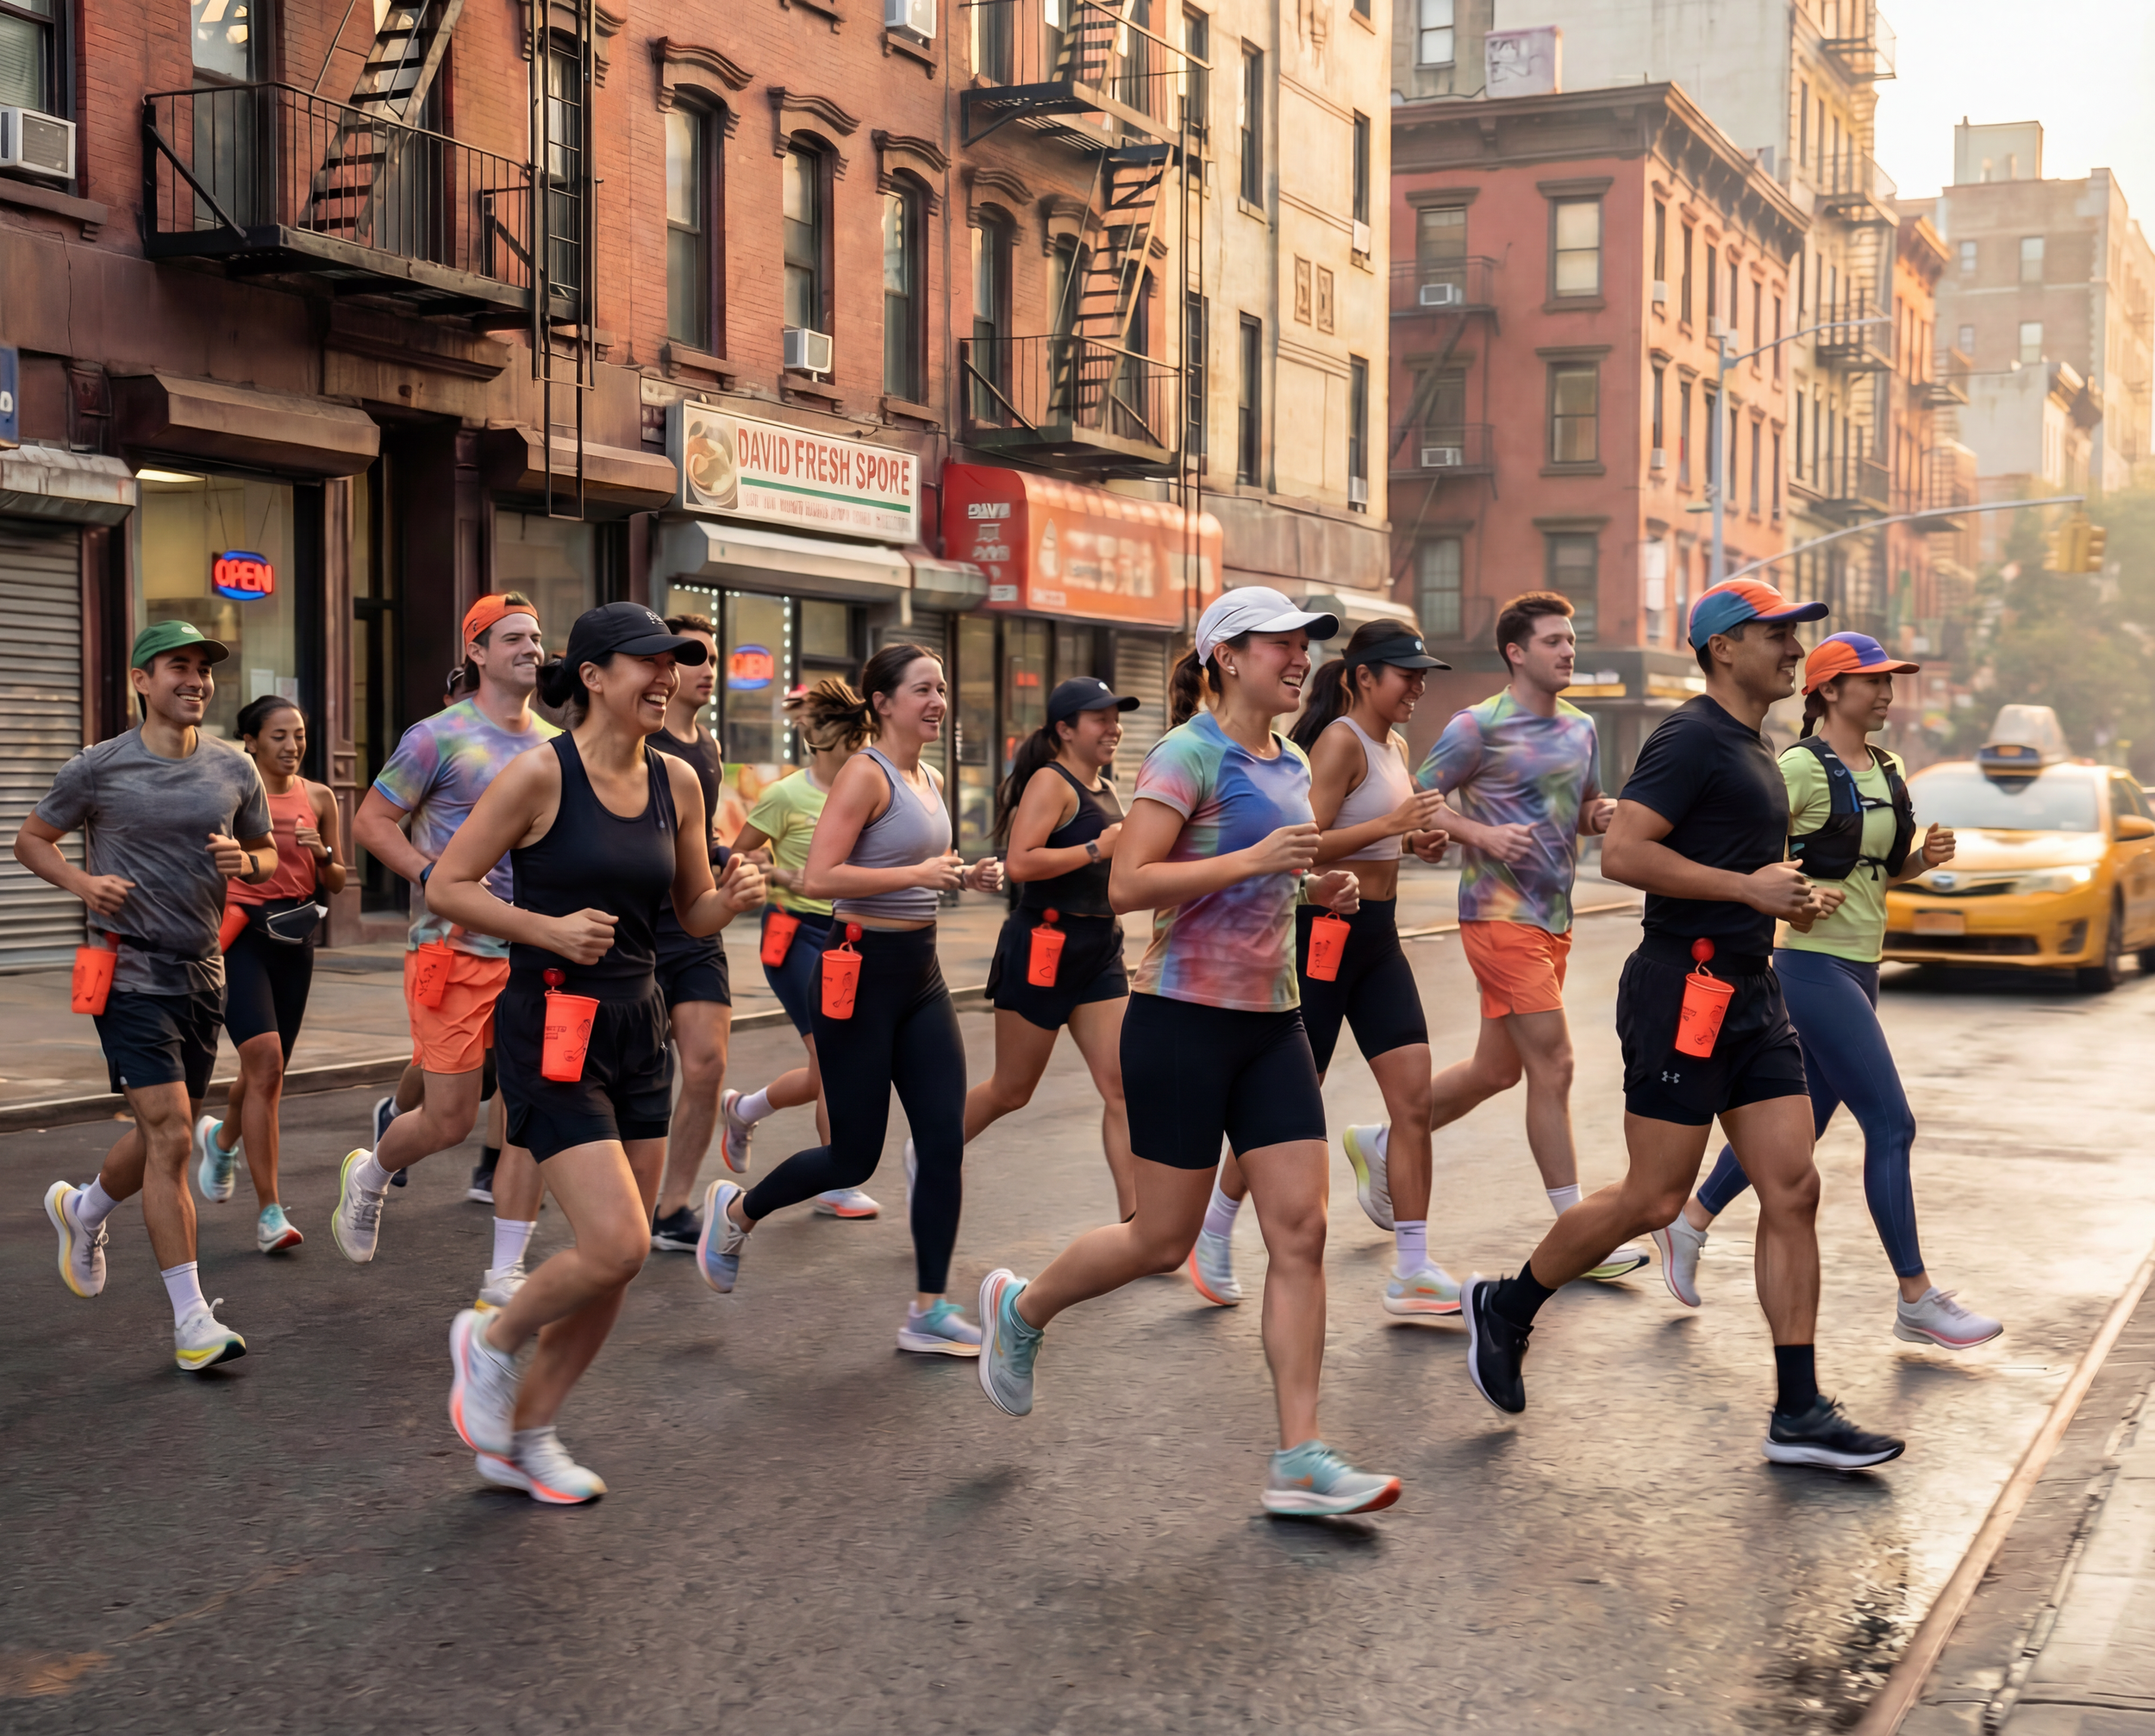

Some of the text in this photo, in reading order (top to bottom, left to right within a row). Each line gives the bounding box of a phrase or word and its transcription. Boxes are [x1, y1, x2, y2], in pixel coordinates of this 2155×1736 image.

[738, 428, 909, 496] DAVID FRESH SPORE
[215, 559, 273, 594] OPEN
